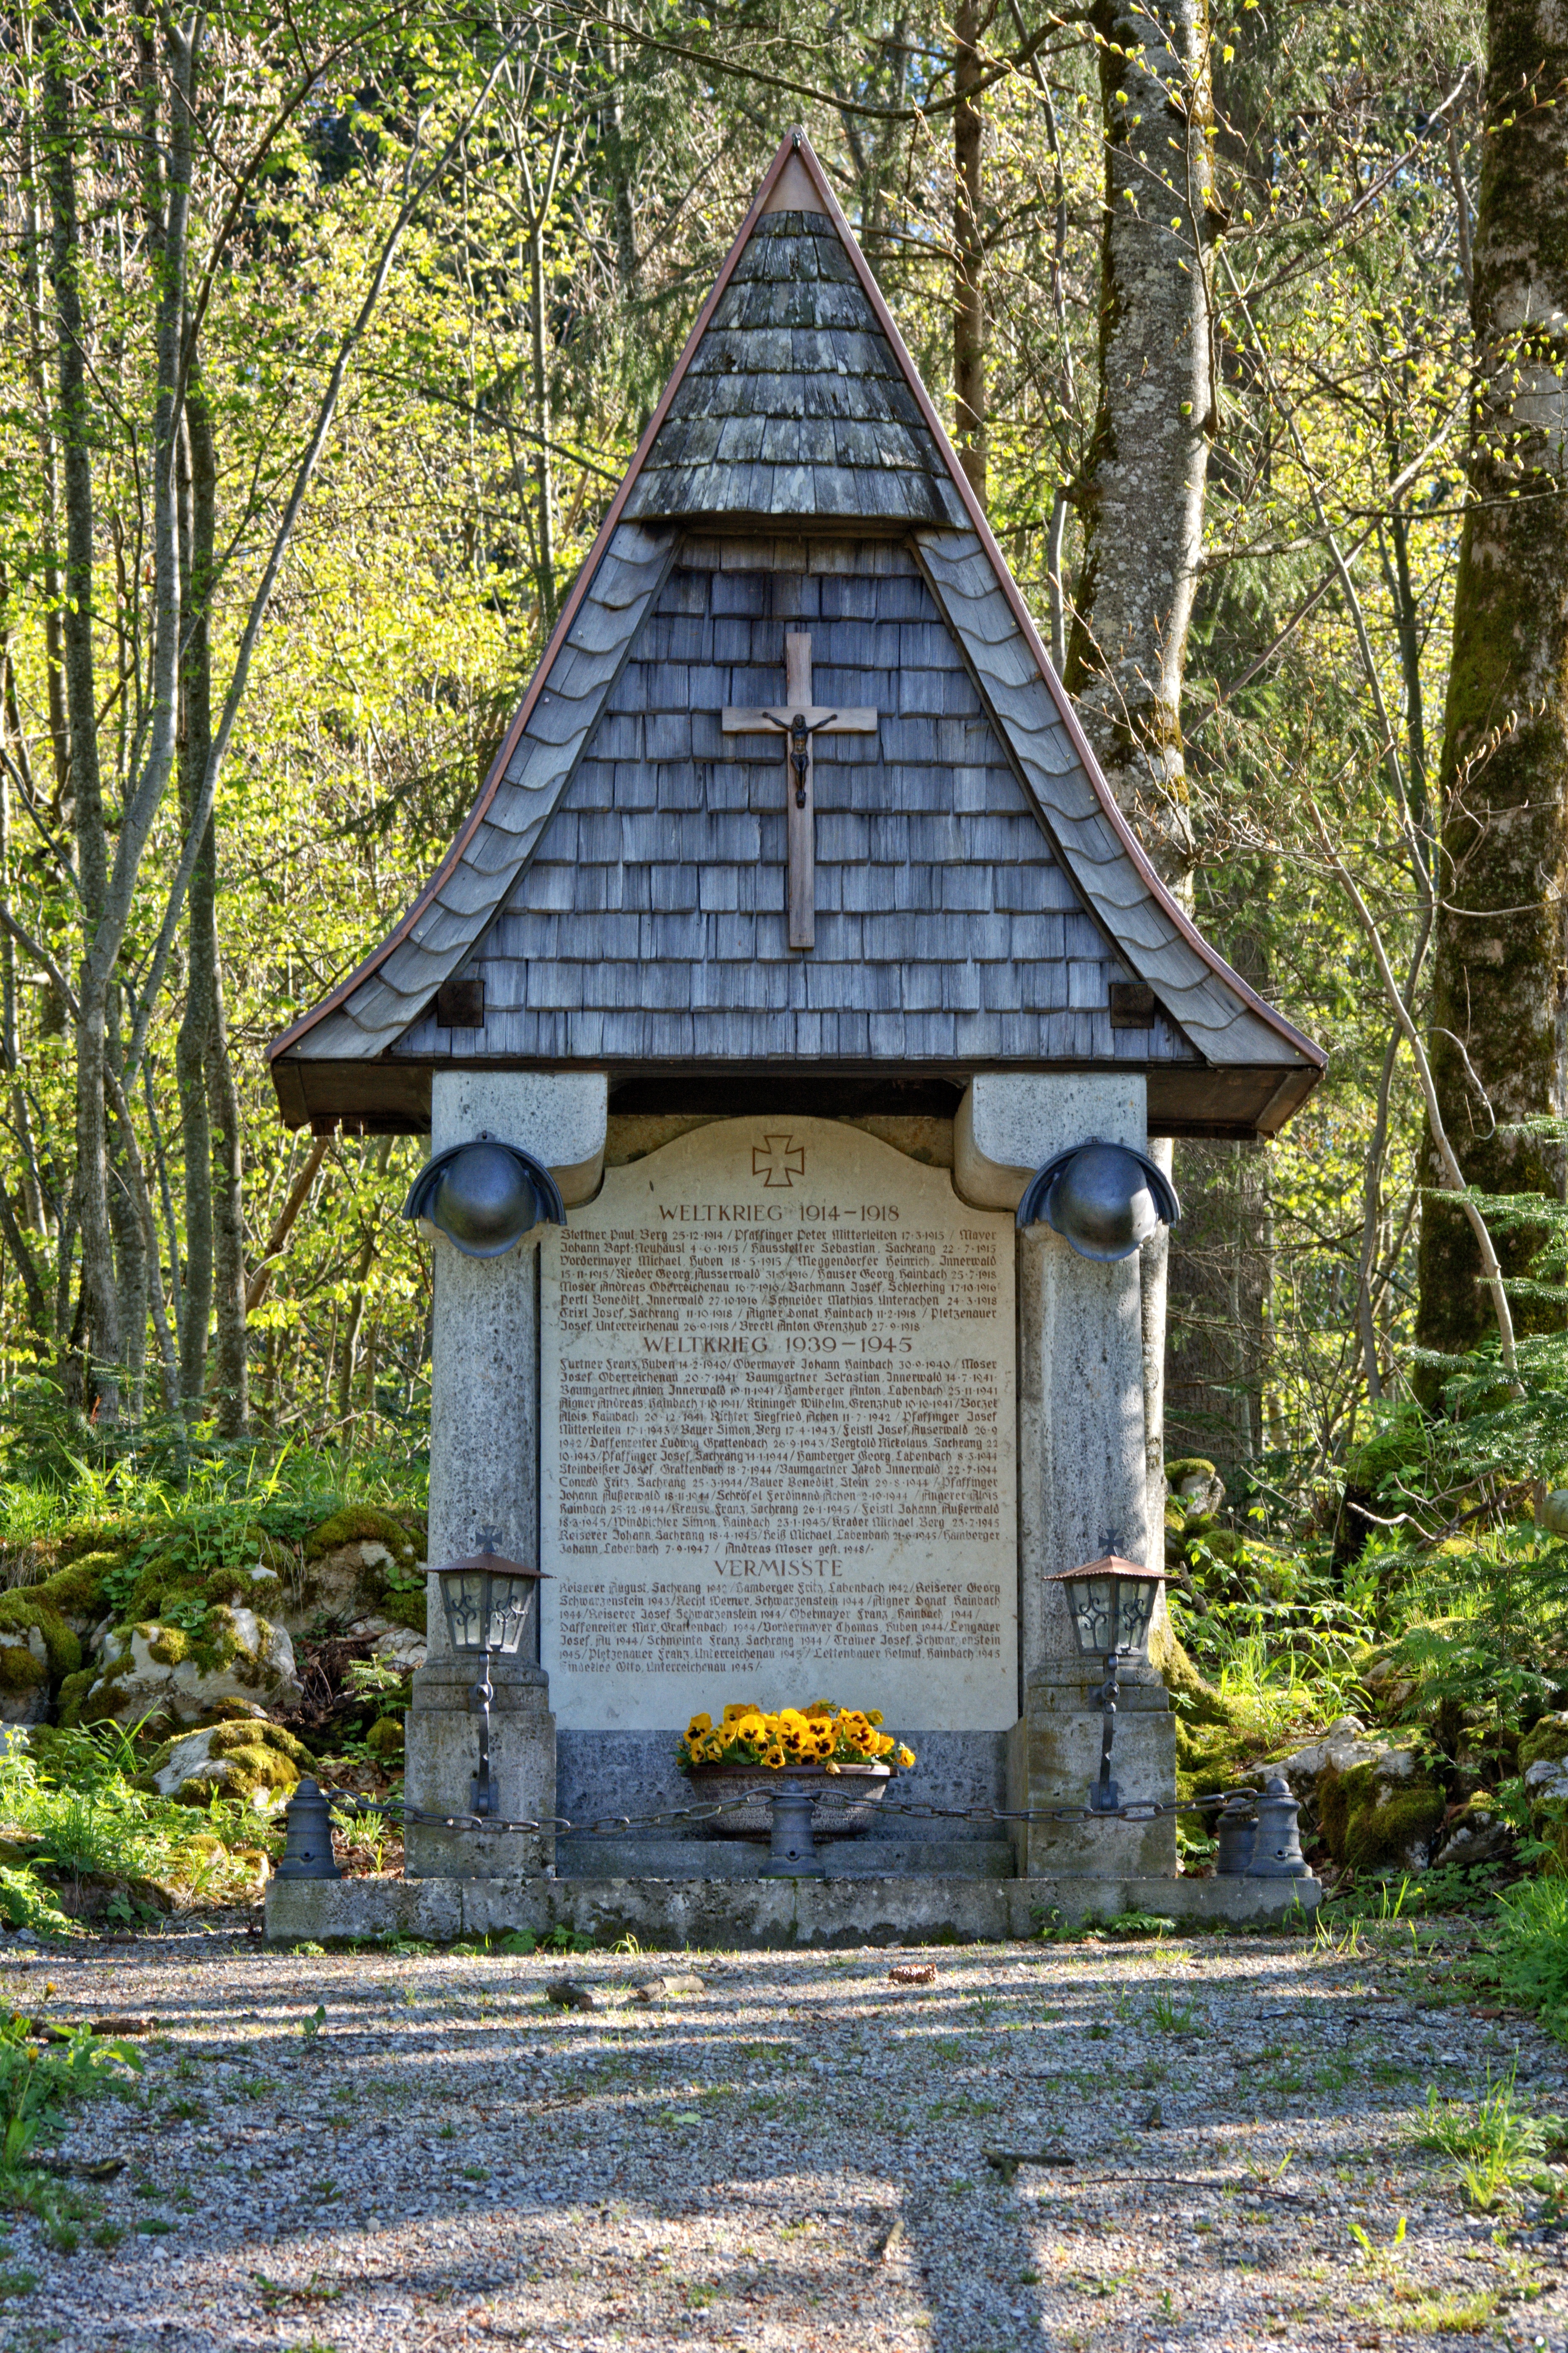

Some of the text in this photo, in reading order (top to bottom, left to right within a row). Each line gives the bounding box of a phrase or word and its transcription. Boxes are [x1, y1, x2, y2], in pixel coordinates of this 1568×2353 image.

[659, 1204, 782, 1221] WELTKRIEG
[561, 1229, 996, 1242] Stettner Berg Pfaffinger Peter Mitterleiten Mayer
[561, 1243, 599, 1255] Johann
[635, 1243, 684, 1255] Neuhäusl
[885, 1243, 935, 1255] Sachrang
[560, 1255, 996, 1268] Vordermayer Huben Meggendorfer Innerwald
[695, 1269, 760, 1279] Ausserwald
[899, 1269, 947, 1281] Hainbach
[560, 1281, 596, 1292] Moser
[650, 1281, 729, 1294] Oberreichenau
[561, 1295, 587, 1308] Pertl
[646, 1295, 703, 1305] Innerwald
[769, 1295, 821, 1308] Schneider
[879, 1295, 939, 1308] Unterachen
[559, 1308, 588, 1318] Trixl
[629, 1308, 679, 1321] Sachrang
[747, 1308, 783, 1321] Aigner
[824, 1308, 873, 1321] Hainbach
[931, 1308, 997, 1321] Pletzenauer
[596, 1321, 678, 1333] Unterreichenau
[777, 1321, 810, 1331] Anton
[813, 1321, 867, 1333] Grenzhub
[644, 1336, 768, 1353] WELTKRIEG
[560, 1358, 602, 1371] Furtner
[641, 1358, 675, 1371] Huben
[801, 1358, 840, 1371] Johann
[845, 1358, 893, 1371] Hainbach
[961, 1358, 998, 1369] Moser
[560, 1372, 942, 1385] Josef Oberreichenau Baumgartner Innerwald
[560, 1385, 630, 1398] Baumgartner
[633, 1385, 663, 1395] Anton
[669, 1385, 726, 1395] Innerwald
[888, 1385, 943, 1398] Labenbach
[559, 1398, 594, 1411] Aigner
[649, 1398, 697, 1411] Hainbach
[849, 1398, 902, 1411] Grenzhub
[592, 1411, 638, 1424] Hainbach
[711, 1411, 748, 1424] Richter
[806, 1411, 838, 1424] Achen
[903, 1411, 960, 1424] Pfaffinger
[967, 1411, 997, 1424] Josef
[559, 1425, 621, 1435] Mitterleiten
[681, 1425, 712, 1435] Bauer
[756, 1425, 781, 1437] Berg
[912, 1425, 968, 1435] Auserwald
[660, 1438, 699, 1451] Ludwig
[704, 1438, 767, 1451] Grattenbach
[934, 1438, 982, 1451] Sachrang
[695, 1451, 743, 1464] Sachrang
[559, 1464, 940, 1477] Steinbeißer Grattenbach Jakob Innerwald
[637, 1478, 684, 1489] Sachrang
[841, 1478, 869, 1487] Stein
[942, 1478, 998, 1489] Pfaffinger
[559, 1490, 597, 1504] Johann
[603, 1490, 660, 1502] Außerwald
[767, 1490, 819, 1504] Ferdinand
[823, 1490, 856, 1504] Achen
[560, 1503, 606, 1517] Hainbach
[752, 1503, 798, 1517] Sachrang
[862, 1503, 893, 1517] Feistl
[942, 1503, 999, 1515] Außerwald
[723, 1517, 770, 1530] Hainbach
[920, 1517, 944, 1530] Berg
[558, 1530, 889, 1543] Reiserer Sachrang Labenbach
[725, 1544, 771, 1553] Andreas
[775, 1544, 813, 1553] Moser
[713, 1559, 843, 1576] VERMISSTE
[559, 1582, 606, 1592] Reiserer
[652, 1582, 701, 1595] Sachrang
[829, 1582, 885, 1595] Labenbach
[889, 1584, 908, 1593] 1942
[967, 1582, 1000, 1595] Georg
[559, 1596, 644, 1608] Schwarzenstein
[755, 1596, 838, 1608] Schwarzenstein
[954, 1596, 1000, 1608] Hainbach
[676, 1609, 757, 1621] Schwarzenstein
[560, 1622, 627, 1634] Daffenreiter
[886, 1622, 917, 1634] Huben
[596, 1635, 611, 1645] Au
[746, 1635, 793, 1647] Sachrang
[834, 1635, 876, 1645] Trainer
[559, 1650, 580, 1659] 1945
[695, 1649, 774, 1661] Unterreichenau
[781, 1650, 802, 1660] 1945
[813, 1649, 882, 1659] Lettenbauer
[927, 1649, 974, 1661] Hainbach
[978, 1649, 1000, 1658] 1945
[646, 1662, 726, 1674] Unterreichenau
